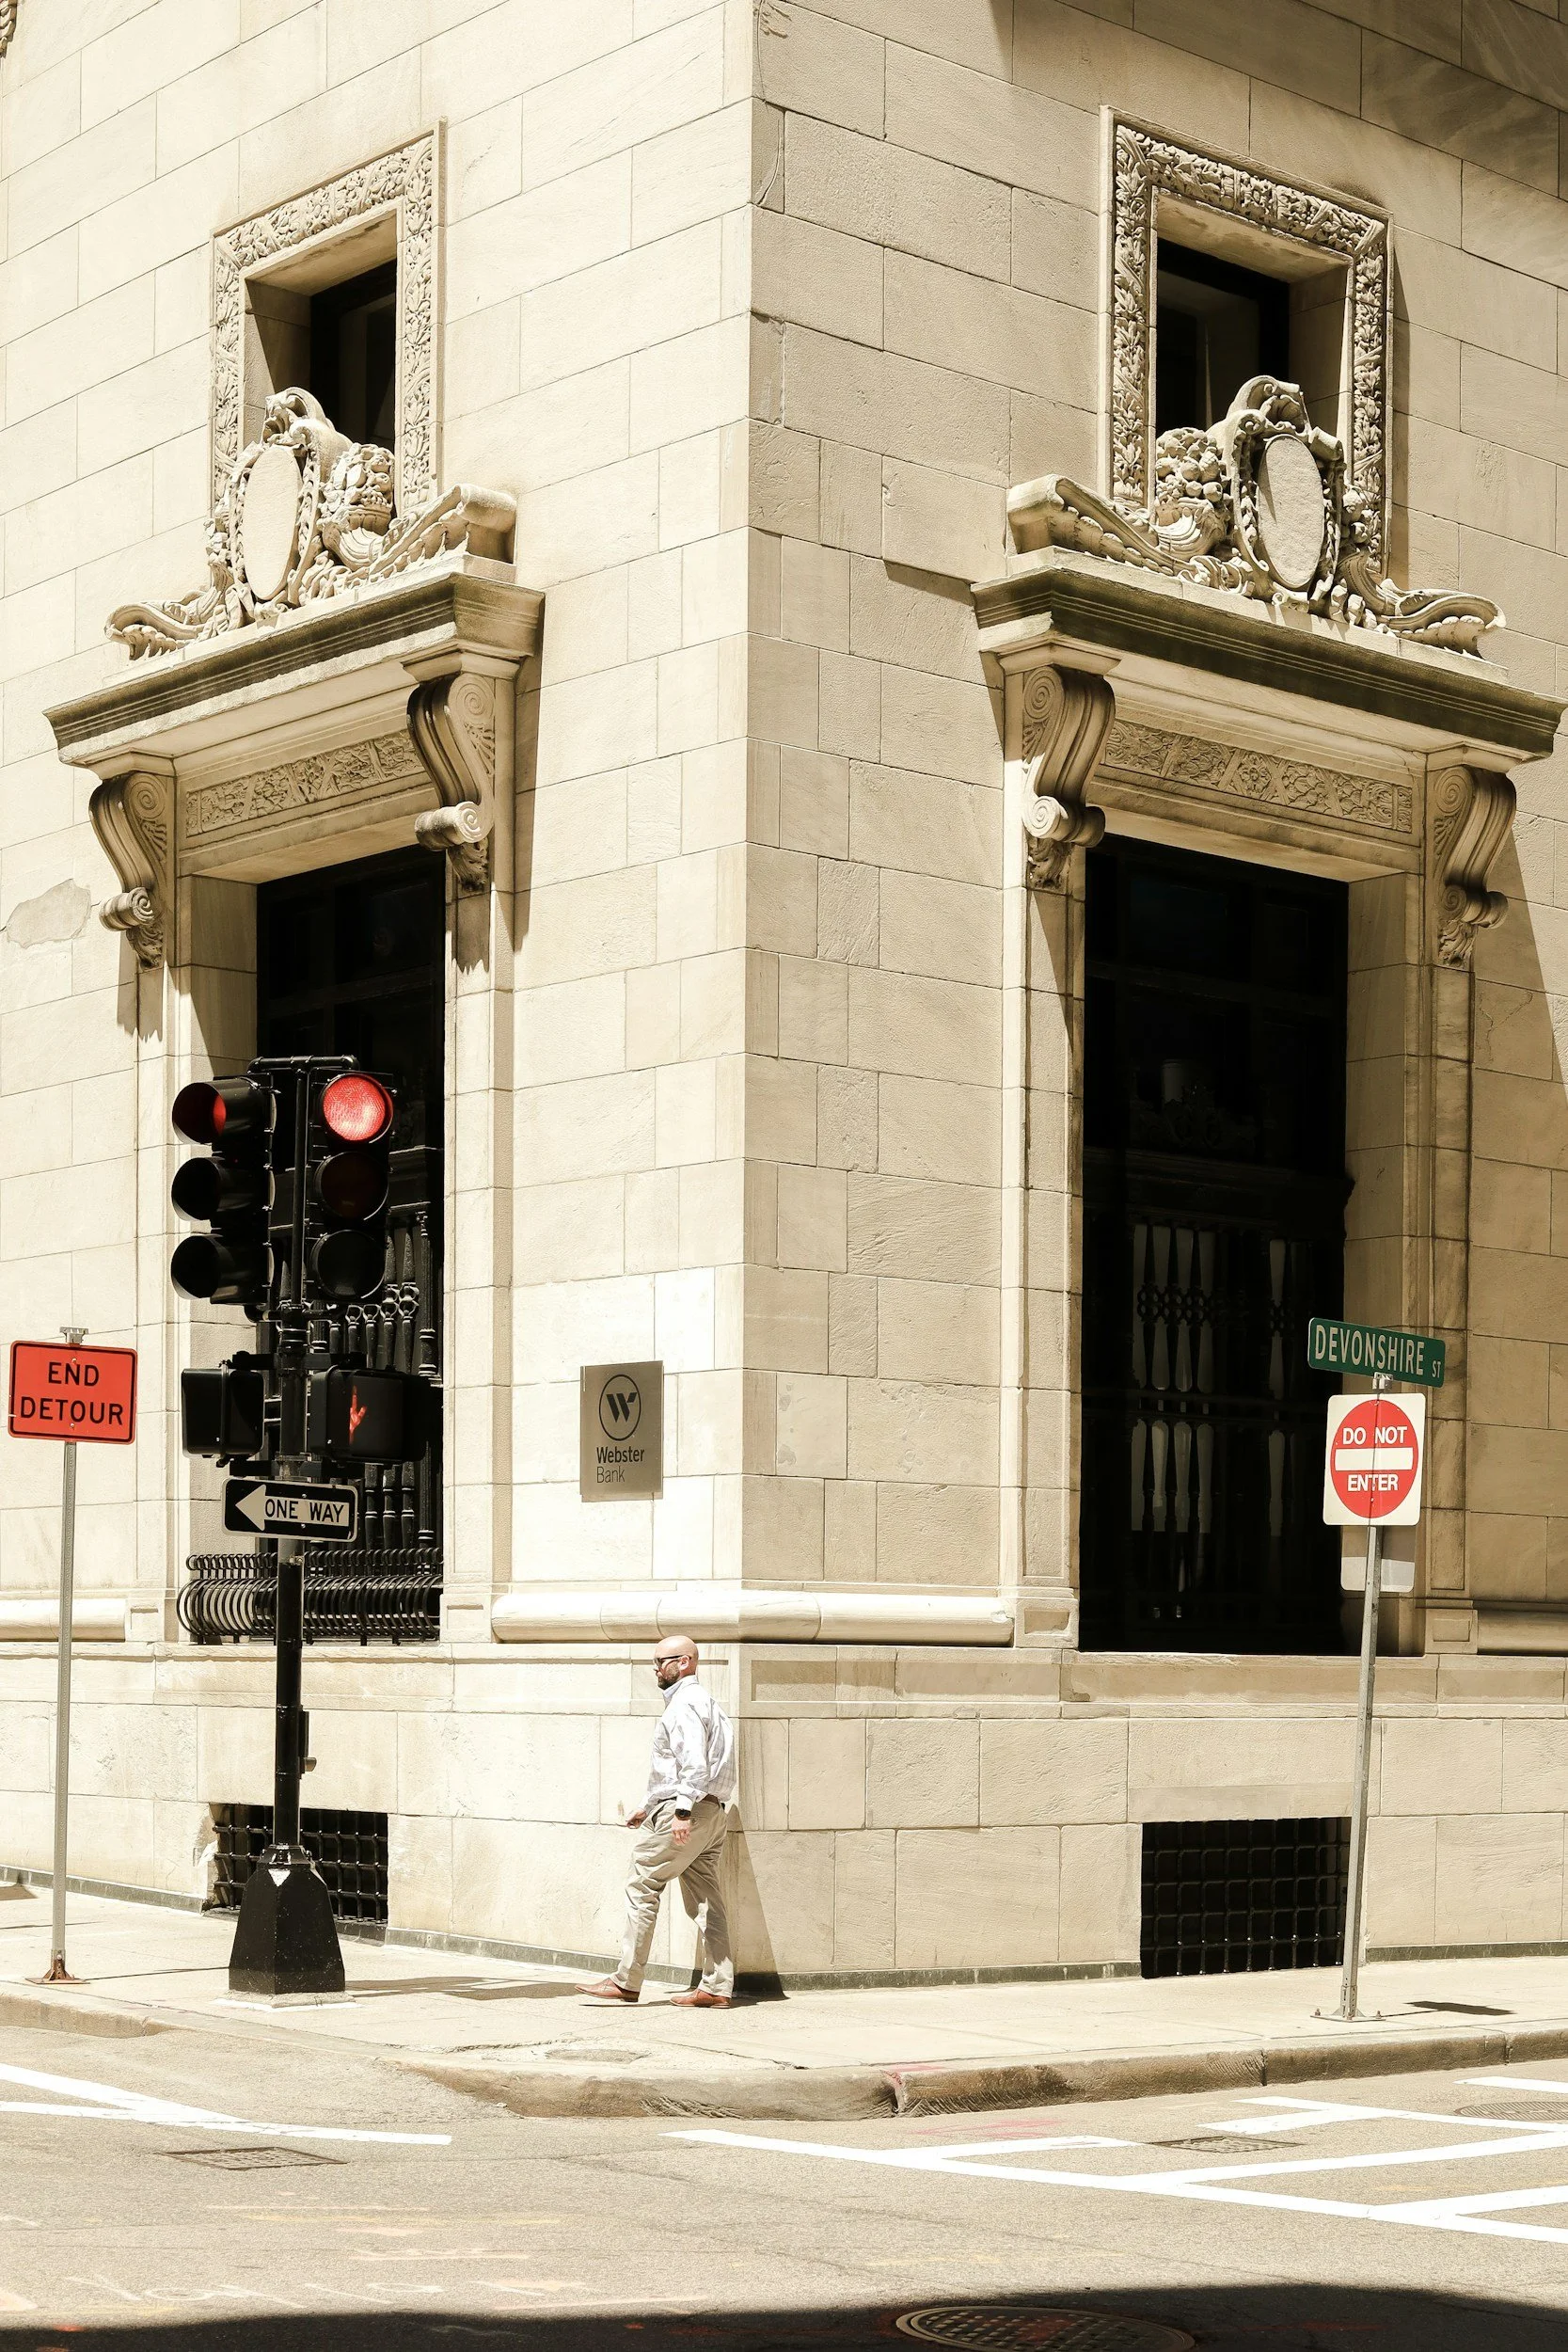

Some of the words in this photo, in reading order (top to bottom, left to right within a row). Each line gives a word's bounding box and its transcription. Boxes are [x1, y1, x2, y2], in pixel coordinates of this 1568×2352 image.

[1315, 1325, 1425, 1375] DEVONSHIRE
[1432, 1360, 1442, 1378] ST
[48, 1361, 100, 1387] END
[20, 1396, 123, 1425] DETOUR
[1342, 1426, 1367, 1445] DO
[1374, 1425, 1408, 1444] NOT
[596, 1445, 645, 1465] Webster
[596, 1465, 626, 1484] Bank
[1347, 1473, 1400, 1492] ENTER
[264, 1499, 299, 1519] ONE
[309, 1502, 344, 1523] WAY
